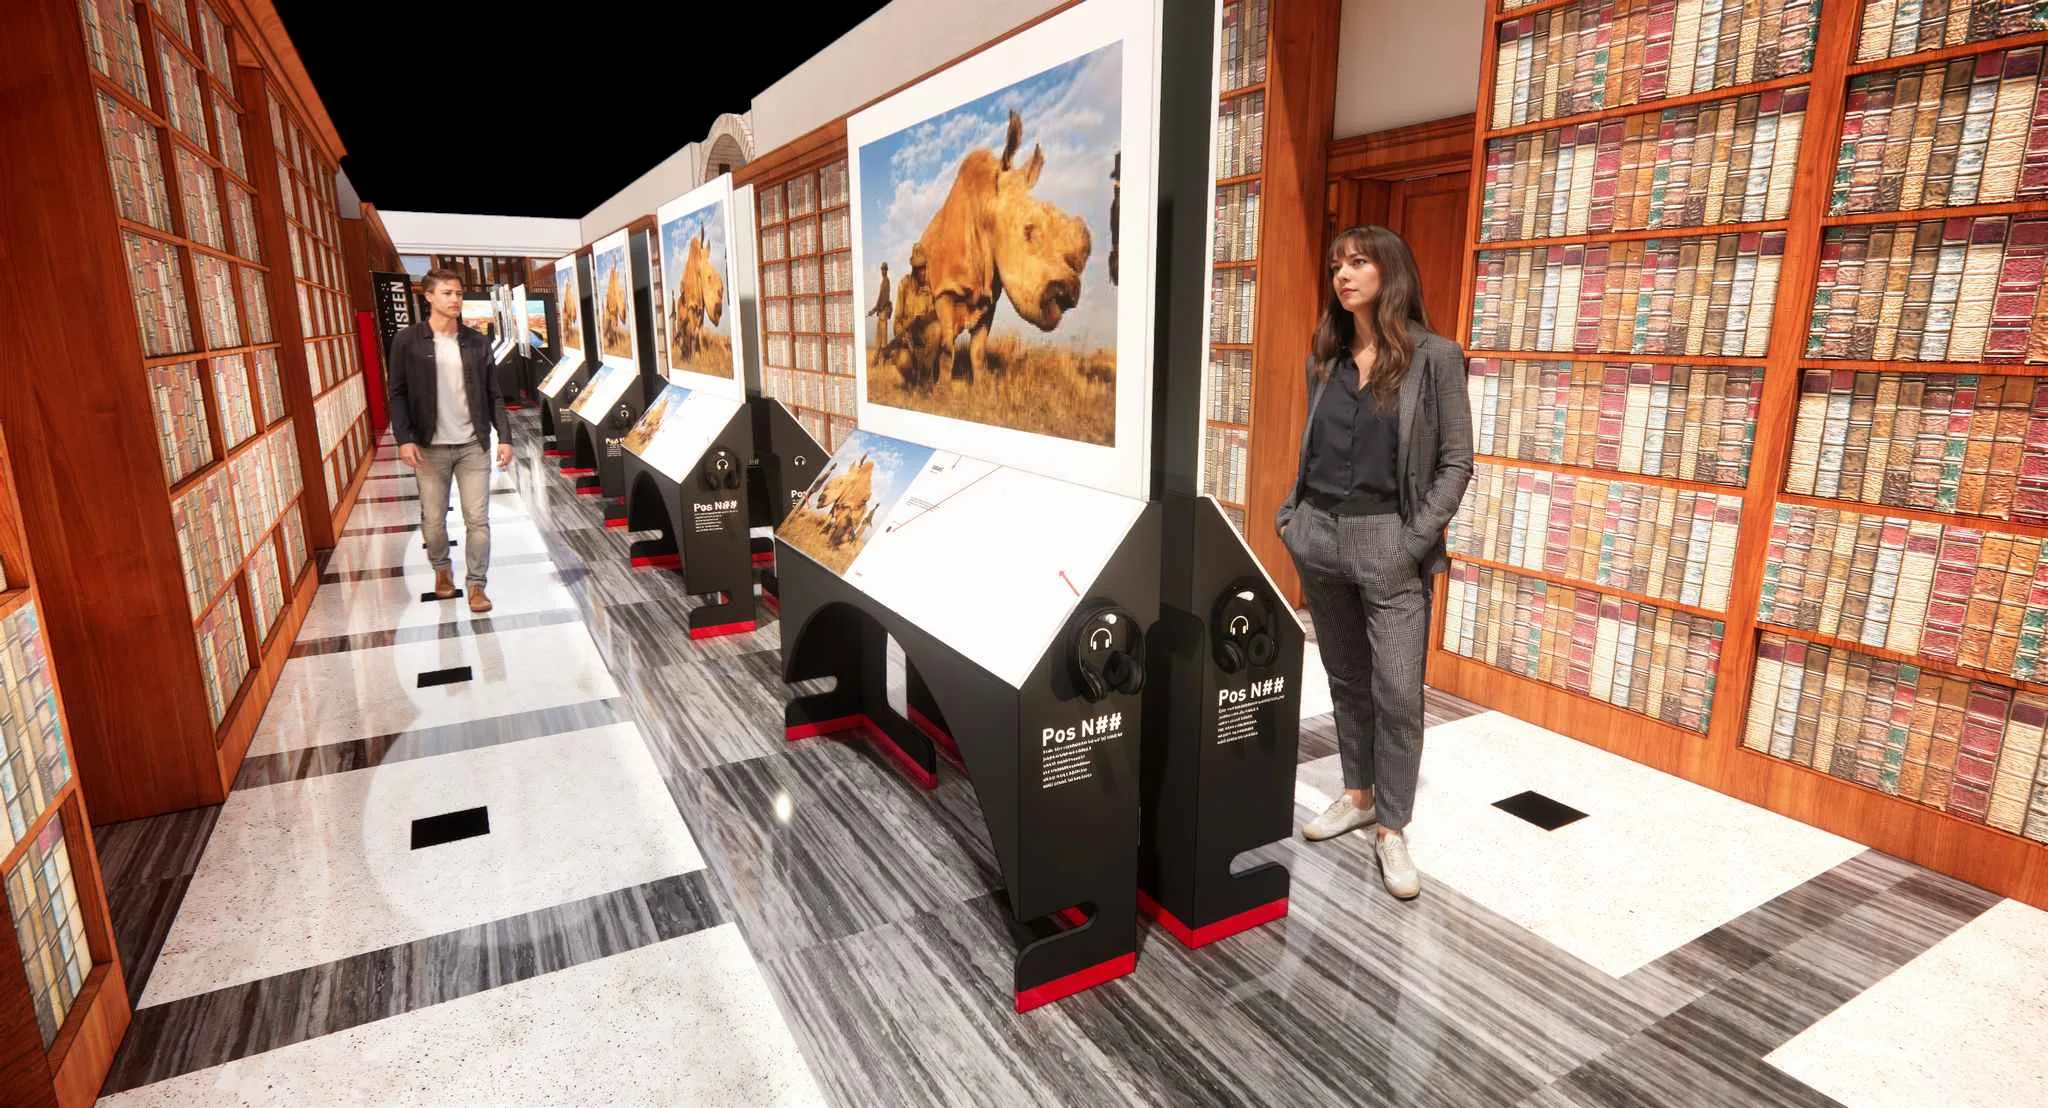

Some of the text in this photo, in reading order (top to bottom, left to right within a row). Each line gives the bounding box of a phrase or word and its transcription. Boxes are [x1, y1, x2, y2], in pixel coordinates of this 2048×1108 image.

[693, 502, 713, 512] Pos
[1218, 676, 1285, 706] Pos N##
[1042, 712, 1122, 747] Pos N##
